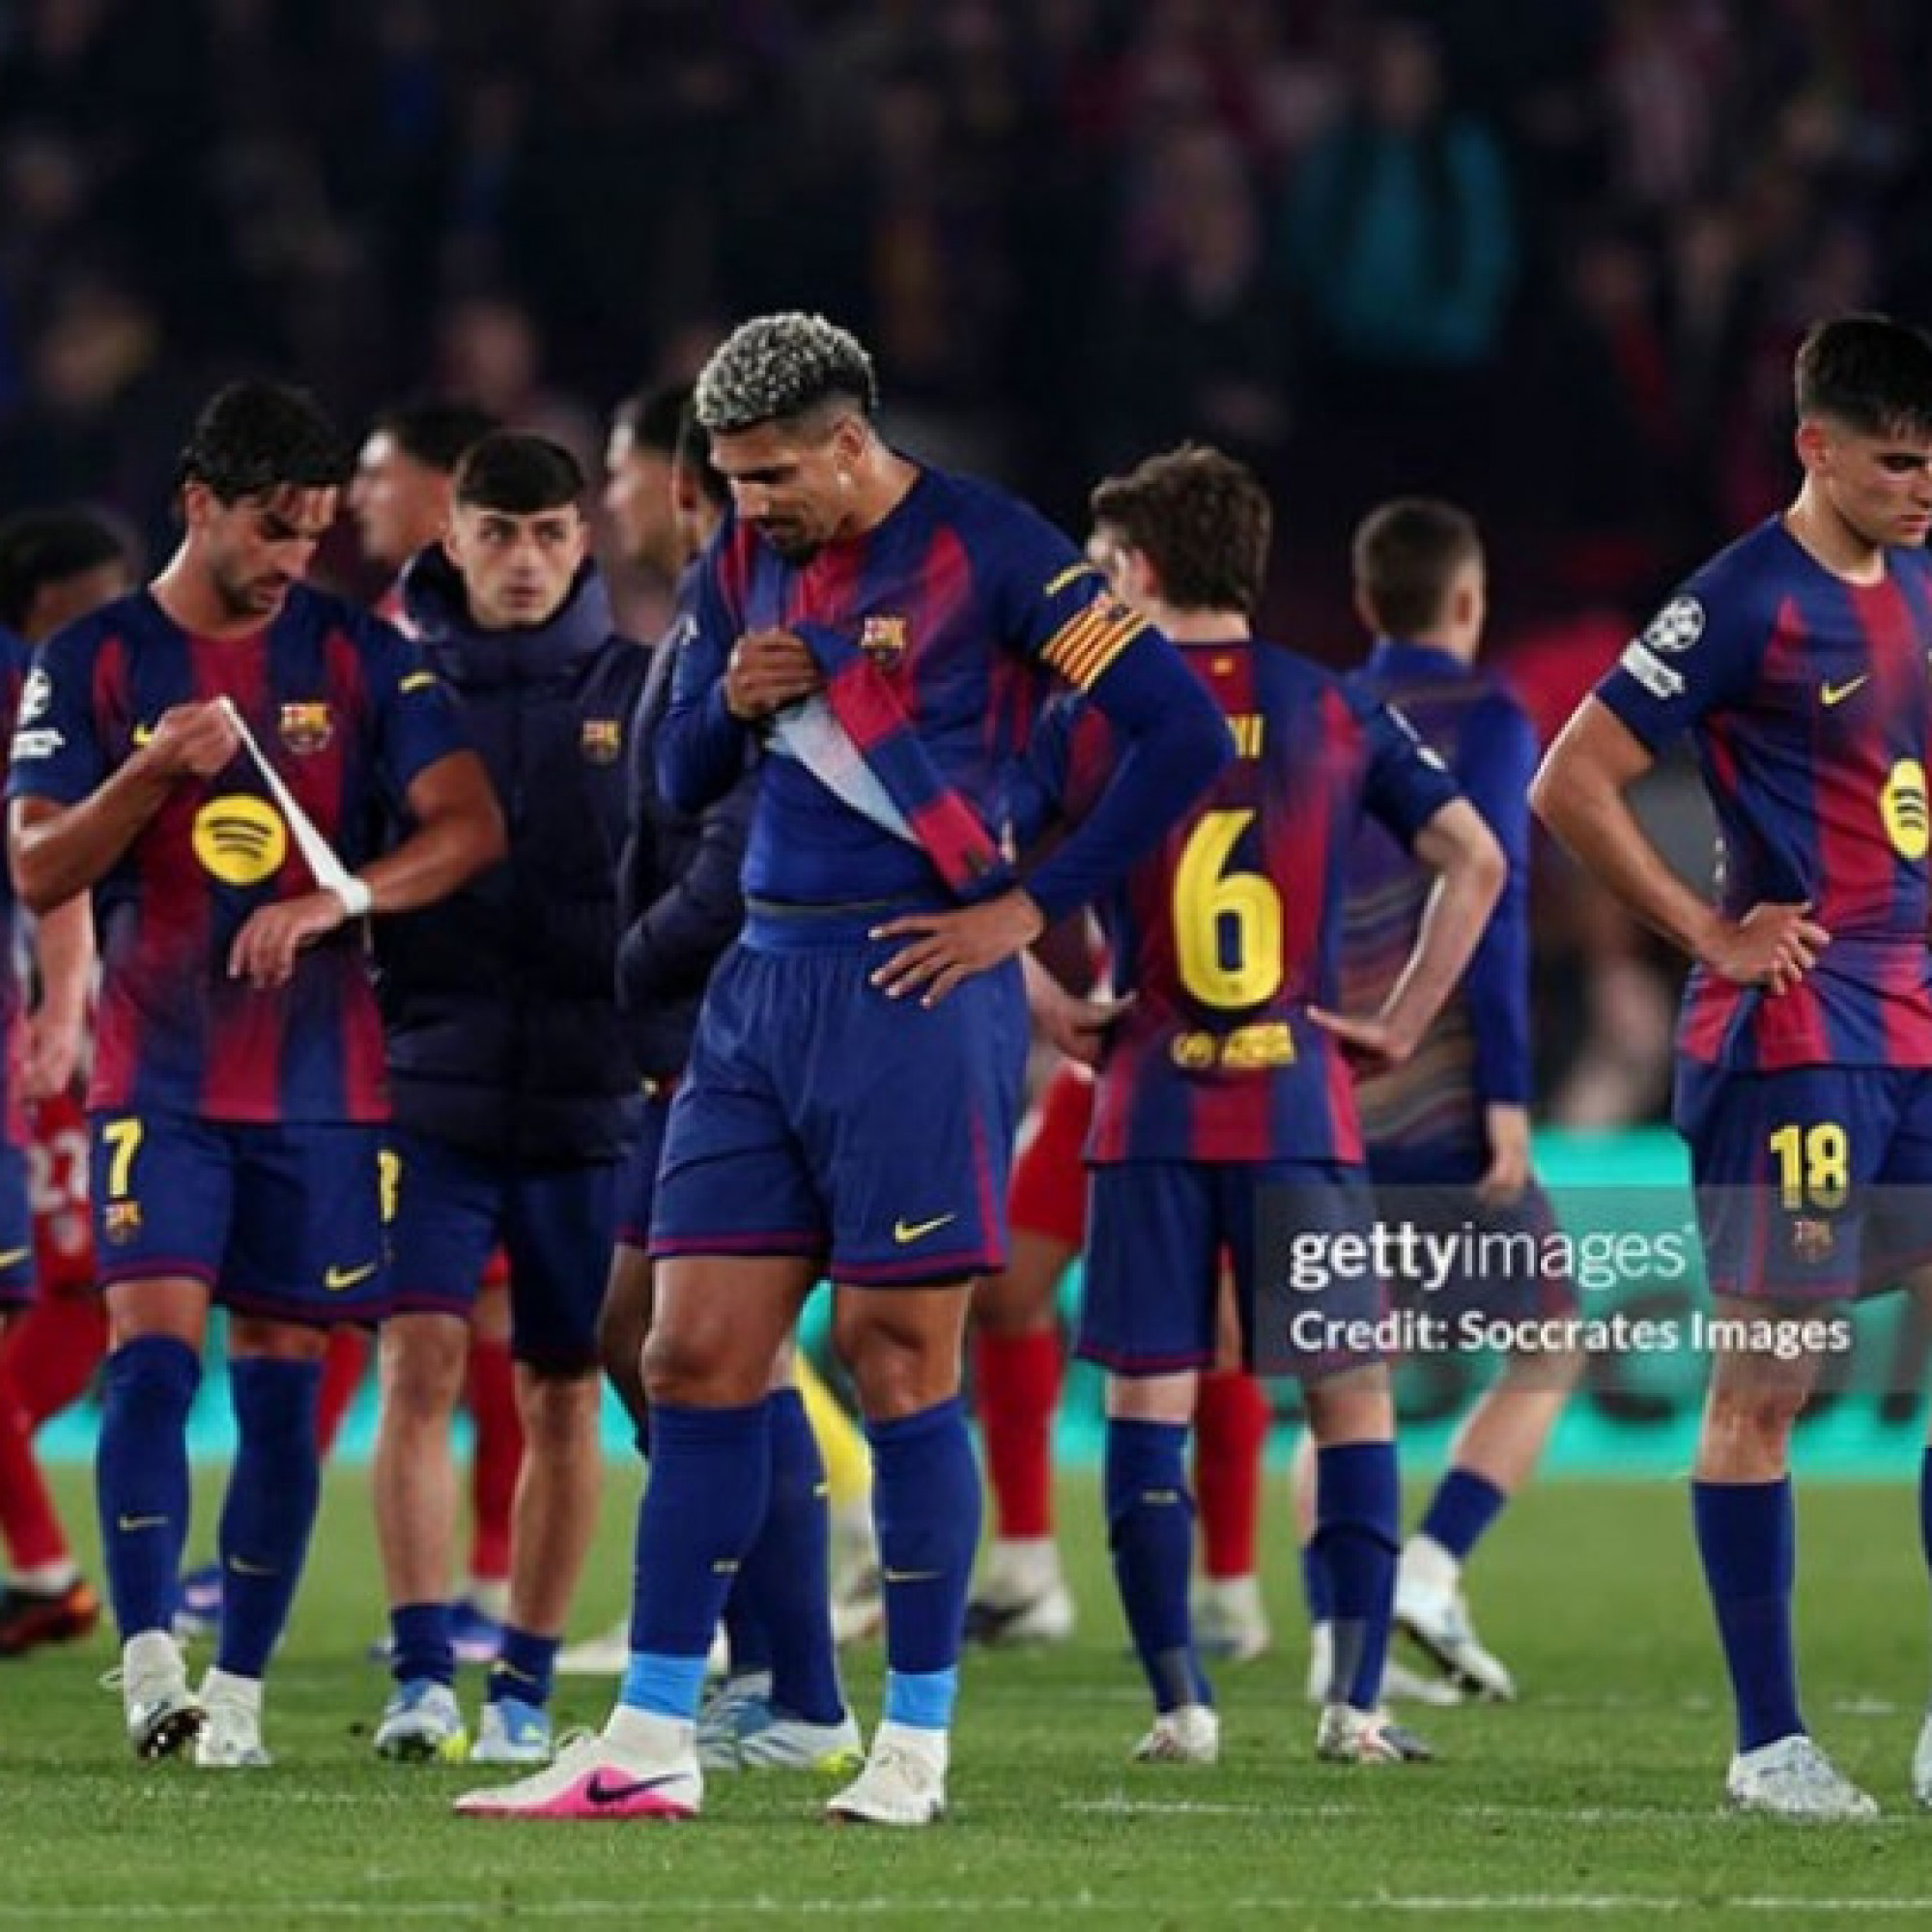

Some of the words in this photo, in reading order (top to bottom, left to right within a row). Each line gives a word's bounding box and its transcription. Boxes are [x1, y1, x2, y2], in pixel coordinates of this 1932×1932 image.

[1173, 808, 1284, 1009] 6
[102, 1119, 142, 1196] 7
[1770, 1123, 1847, 1208] 18
